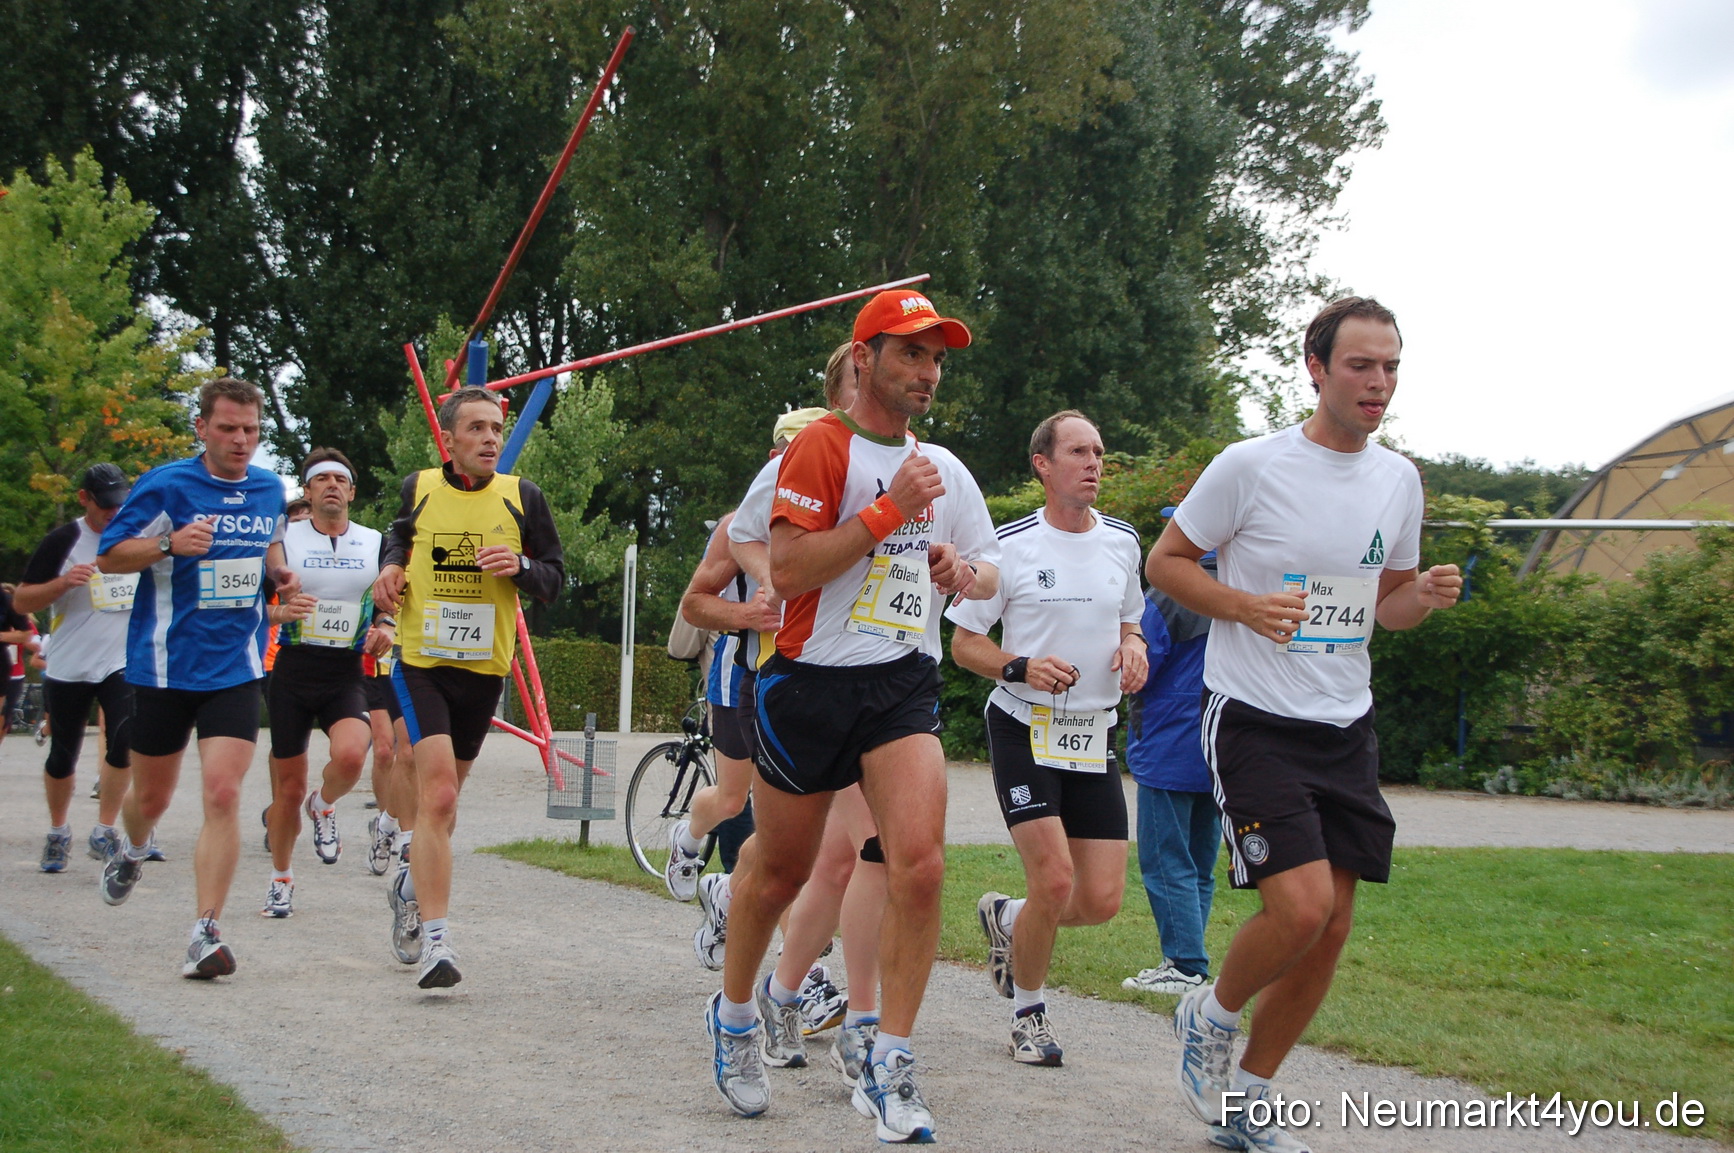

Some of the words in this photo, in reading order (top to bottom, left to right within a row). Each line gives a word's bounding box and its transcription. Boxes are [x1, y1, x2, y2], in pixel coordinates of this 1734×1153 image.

[778, 487, 824, 513] MERZ
[883, 541, 913, 555] TEAM
[303, 557, 365, 569] BOCK
[221, 572, 258, 589] 3540
[434, 573, 482, 584] HIRSCH
[888, 563, 919, 584] Roland
[110, 584, 134, 598] 832
[864, 584, 872, 595] B
[1310, 581, 1334, 596] Max
[318, 604, 342, 614] Rudolf
[889, 591, 922, 618] 426
[442, 607, 473, 620] Distler
[1309, 604, 1365, 627] 2744
[322, 619, 349, 633] 440
[424, 622, 430, 631] B
[448, 625, 482, 642] 774
[1033, 729, 1039, 739] B
[1057, 733, 1094, 752] 467
